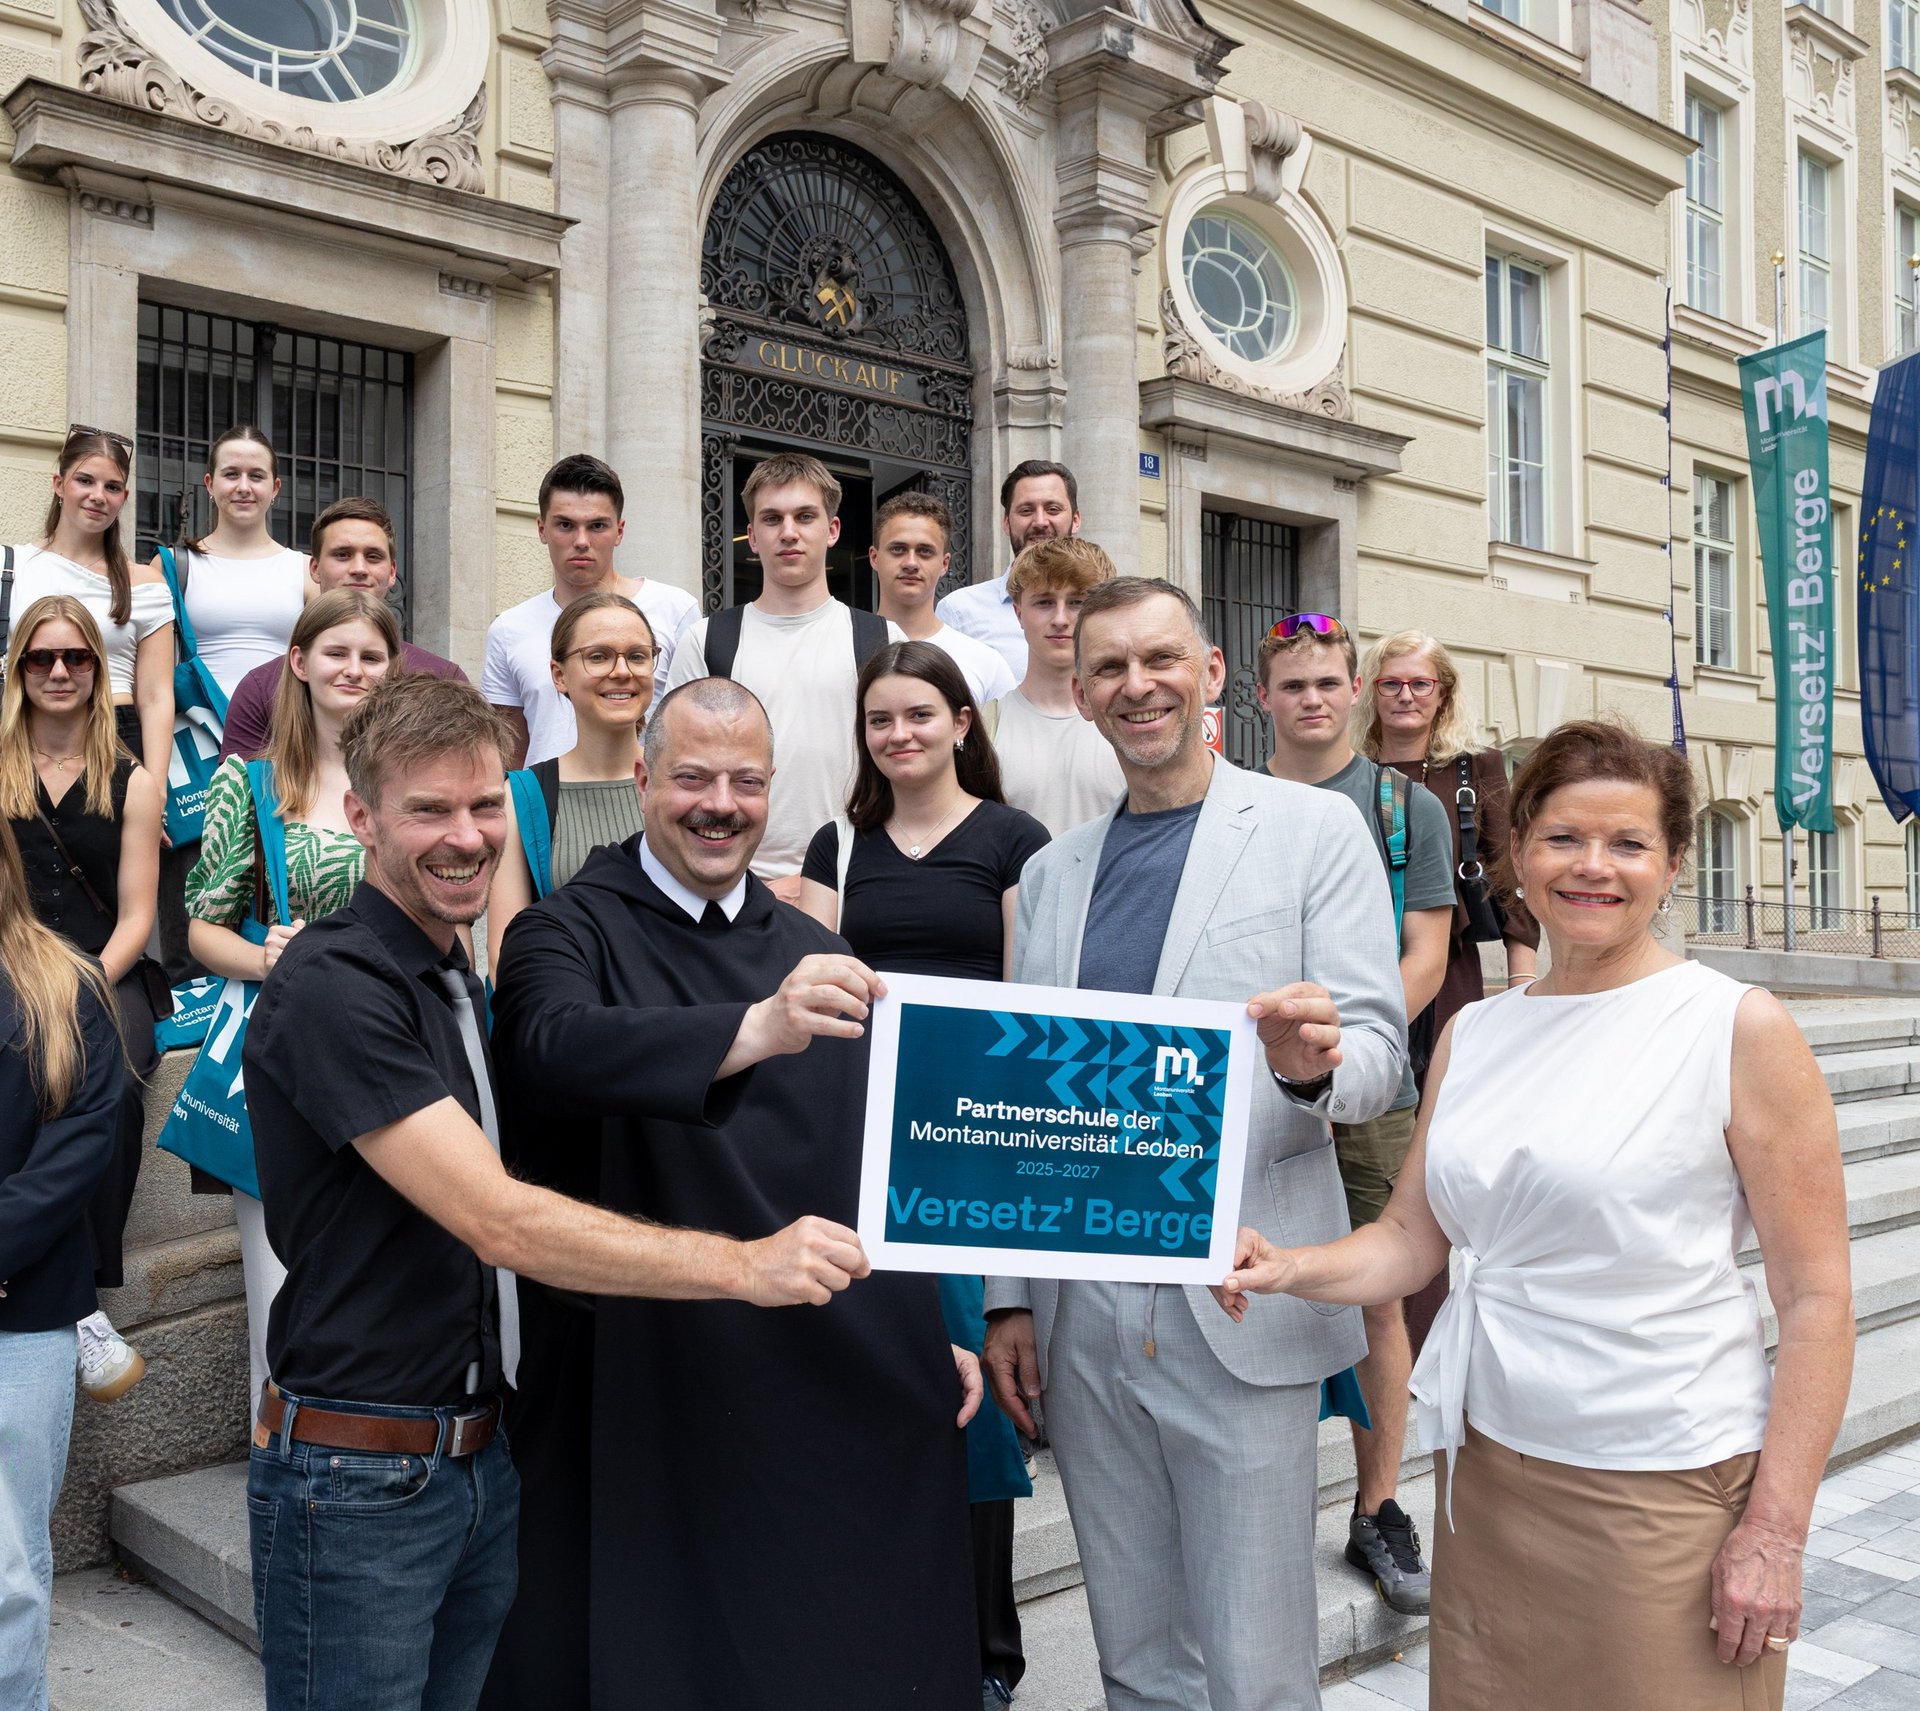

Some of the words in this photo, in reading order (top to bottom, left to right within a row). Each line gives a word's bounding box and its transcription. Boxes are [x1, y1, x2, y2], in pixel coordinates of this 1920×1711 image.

[1144, 455, 1154, 470] 18
[1788, 468, 1828, 607] Berge
[956, 1097, 1119, 1127] Partnerschule
[1123, 1110, 1160, 1130] der
[910, 1121, 1118, 1154] Montanuniversität
[1124, 1136, 1204, 1159] Leoben
[1084, 1198, 1212, 1249] Berge
